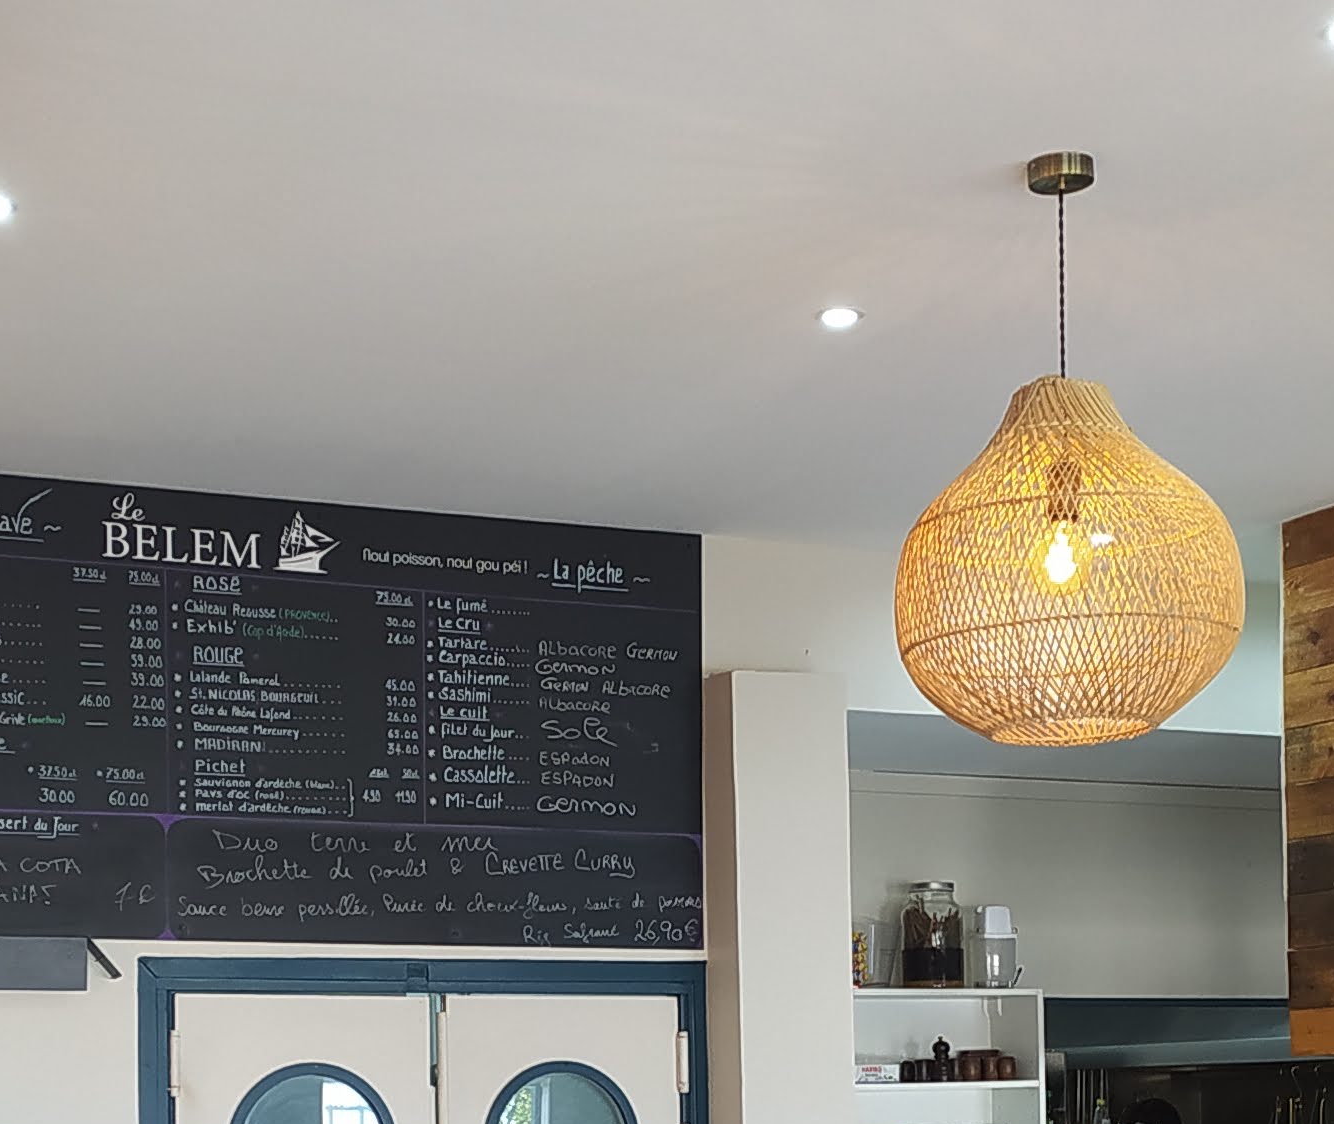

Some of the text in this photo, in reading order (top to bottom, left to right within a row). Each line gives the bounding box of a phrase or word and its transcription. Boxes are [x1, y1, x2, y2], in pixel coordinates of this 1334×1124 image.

[111, 493, 145, 520] Le
[102, 520, 262, 570] BELEM
[363, 548, 389, 563] Nout
[393, 551, 443, 568] poisson,
[447, 557, 472, 569] nout
[476, 560, 499, 573] gou
[554, 558, 623, 592] La pêche
[437, 599, 451, 610] Le
[385, 618, 415, 628] 30.00
[439, 617, 452, 629] Le
[130, 637, 161, 649] 28.00
[438, 636, 488, 650] Tartare
[438, 650, 505, 668] Carpaccio
[131, 673, 164, 687] 39.00
[190, 672, 231, 684] Lalande
[438, 669, 510, 686] Tahitienne
[79, 695, 111, 707] 16.00
[439, 686, 492, 704] Sashimi
[218, 707, 228, 717] du
[387, 712, 417, 723] 26.00
[441, 706, 454, 717] Le
[133, 715, 166, 728] 29.00
[473, 726, 486, 737] du
[443, 745, 505, 761] Brochette
[195, 759, 245, 773] Pichet
[444, 765, 515, 784] Cassolette
[108, 791, 149, 807] 60.00
[445, 792, 504, 808] Mi-Cuit
[34, 819, 48, 831] du
[213, 829, 278, 850] Duo
[395, 832, 416, 852] et
[197, 855, 313, 889] Brochette
[330, 857, 354, 879] de
[370, 858, 428, 883] poulet
[451, 858, 464, 874] &
[178, 896, 227, 917] Sauce
[436, 895, 455, 911] de
[632, 892, 645, 908] de
